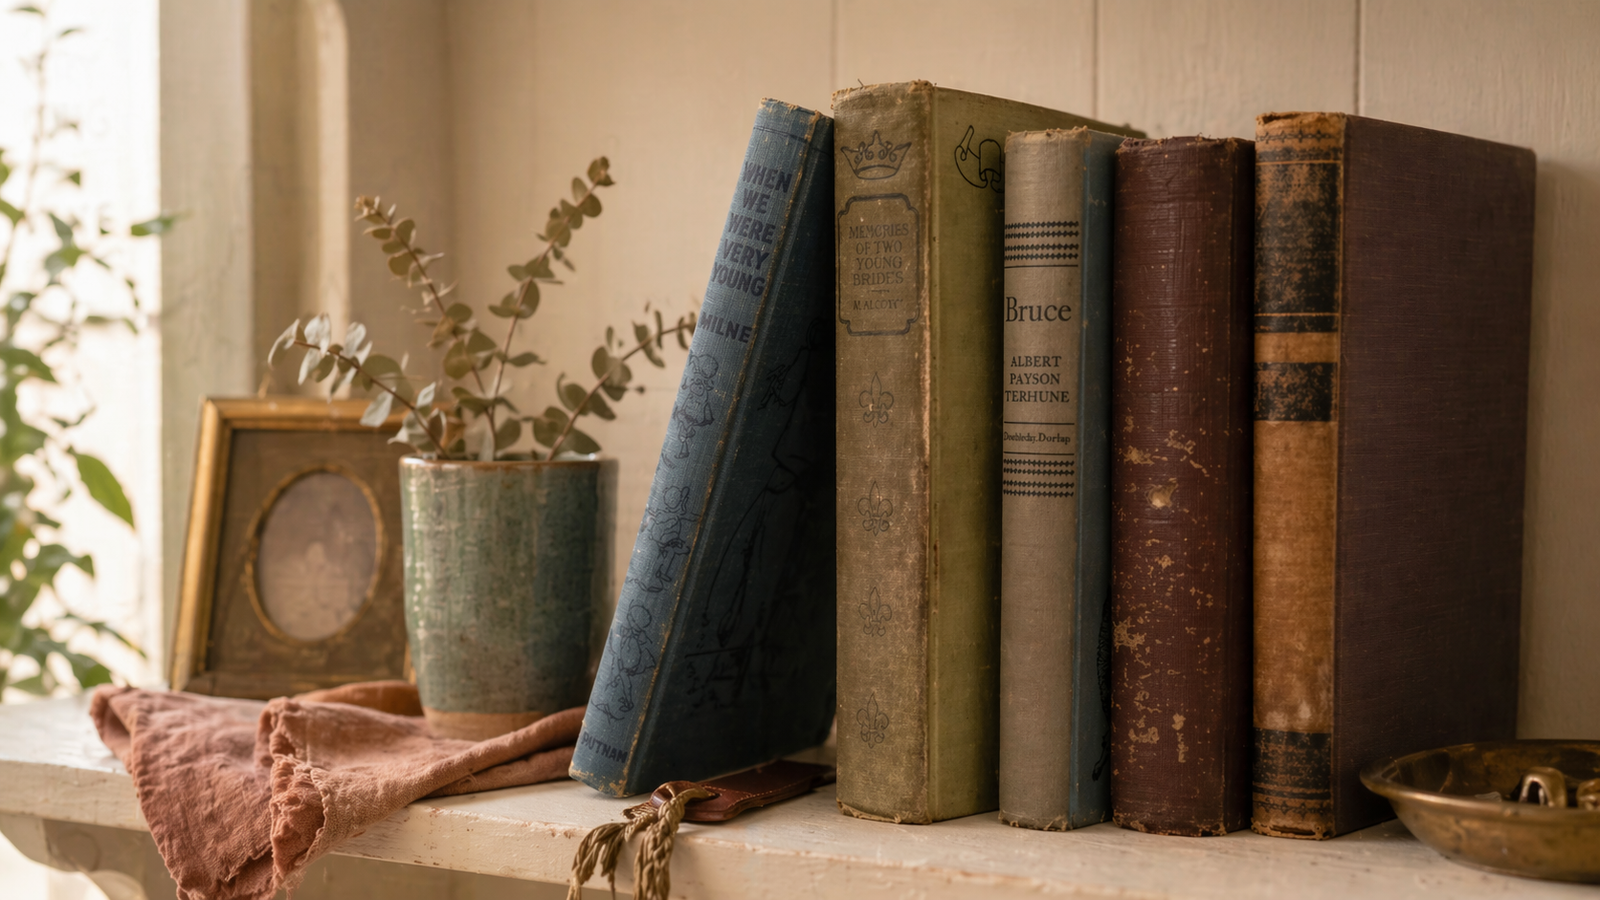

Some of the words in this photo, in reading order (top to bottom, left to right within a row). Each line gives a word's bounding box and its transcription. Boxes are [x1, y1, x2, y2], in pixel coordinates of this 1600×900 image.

[743, 161, 792, 193] WHEN
[742, 188, 770, 214] WE
[728, 212, 776, 244] WERE
[848, 223, 909, 239] MEMORIES
[723, 239, 769, 270] VERY
[856, 242, 870, 255] OF
[873, 240, 903, 254] TWO
[856, 256, 903, 270] YOUNG
[711, 262, 765, 297] YOUNG
[853, 271, 904, 286] BRIDES
[1005, 296, 1072, 322] Bruce
[699, 311, 752, 343] MILNE
[1010, 355, 1062, 368] ALBERT
[1009, 372, 1061, 385] PAYSON
[1004, 389, 1070, 402] TERHUNE
[581, 731, 628, 763] PUTNAM
